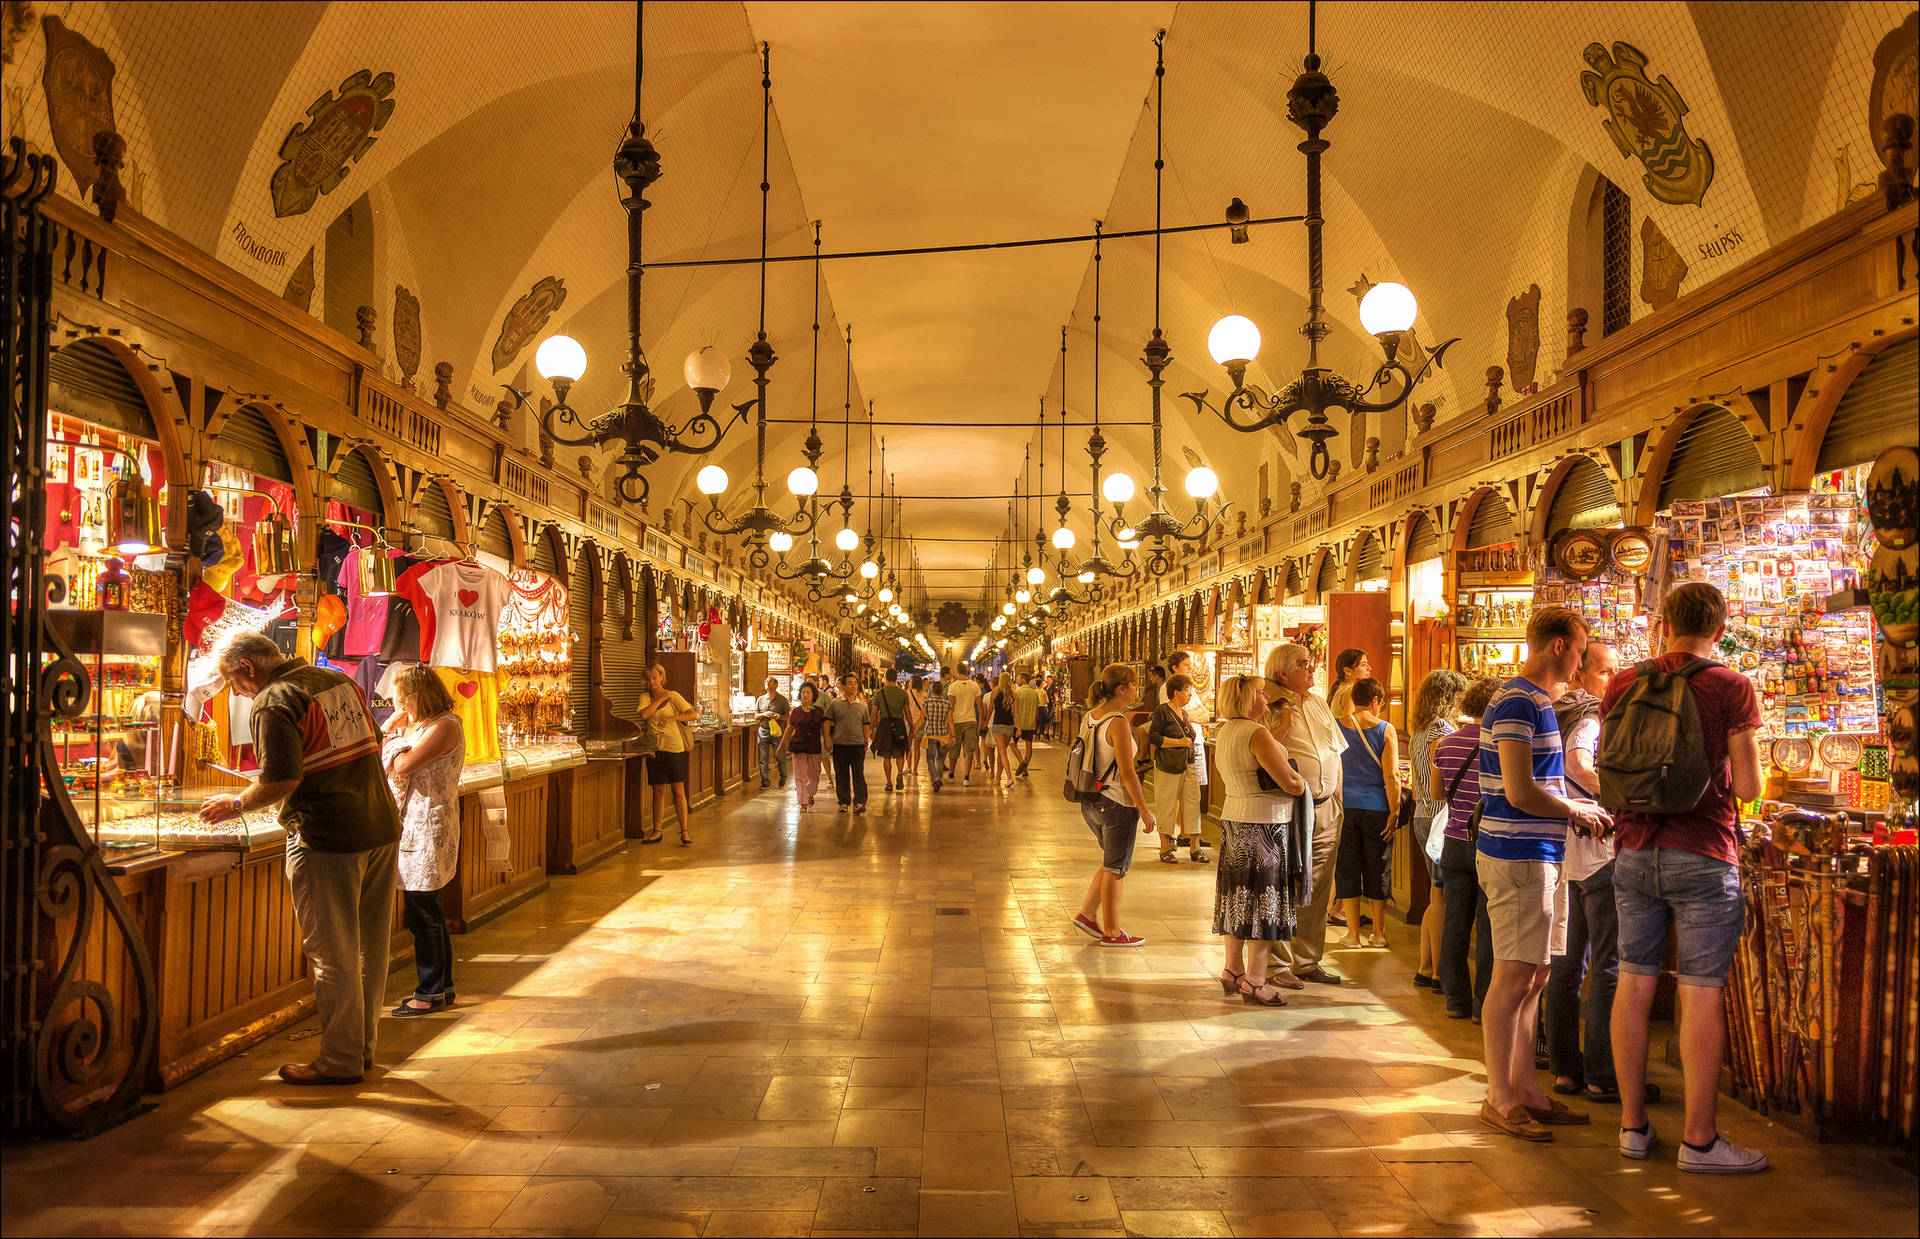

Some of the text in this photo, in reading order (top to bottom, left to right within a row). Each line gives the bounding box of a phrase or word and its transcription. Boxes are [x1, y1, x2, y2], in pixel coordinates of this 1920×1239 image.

[232, 221, 288, 267] FROMBORK
[1698, 227, 1744, 260] SŁUPSK
[449, 609, 486, 619] KRAKÓW
